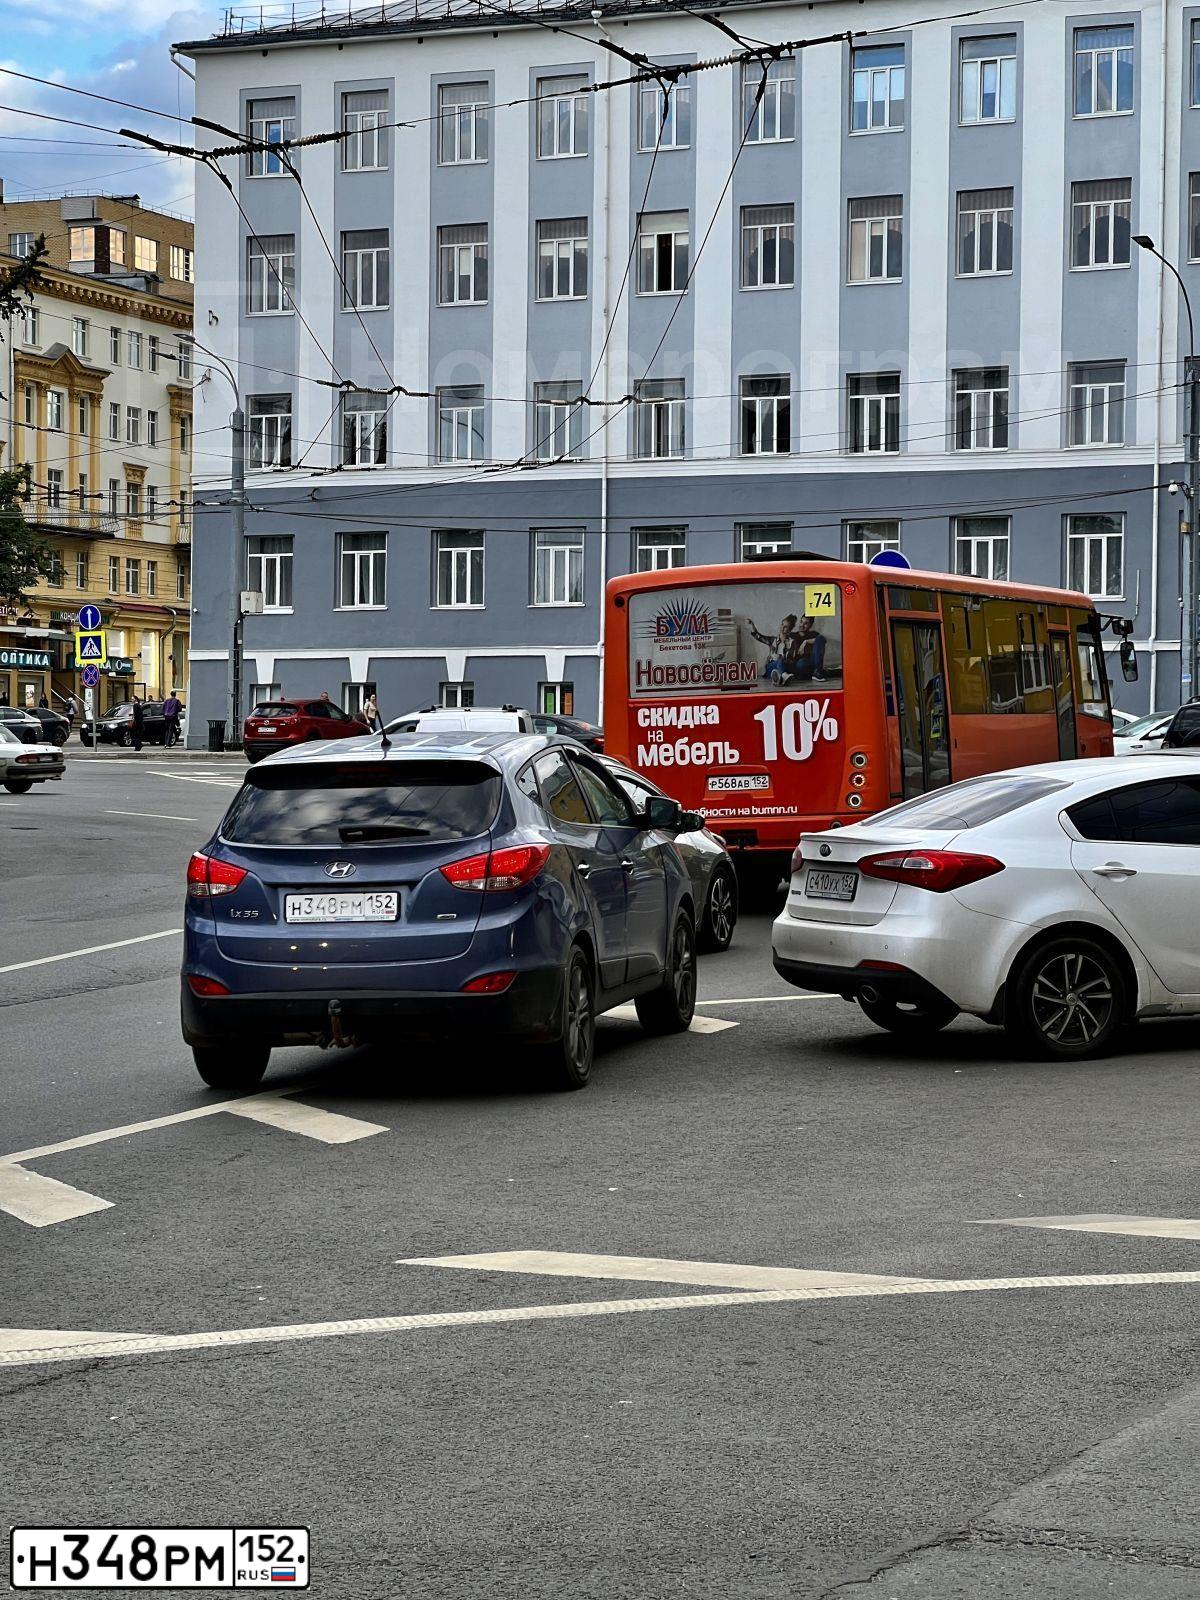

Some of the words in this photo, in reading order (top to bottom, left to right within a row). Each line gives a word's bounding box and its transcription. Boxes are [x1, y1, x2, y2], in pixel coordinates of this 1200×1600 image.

[655, 613, 709, 636] БУМ
[653, 636, 691, 644] МЕБЕЛЬНЫЙ
[1, 652, 49, 666] ОПТИКА
[635, 657, 758, 687] Новосёлам
[637, 704, 719, 728] скидка
[648, 730, 663, 742] на
[754, 699, 838, 761] 10%
[638, 737, 740, 767] мебель
[711, 778, 750, 789] Р568АВ
[751, 776, 767, 785] 152
[738, 807, 751, 815] на
[752, 804, 798, 815] bumnn.ru
[841, 875, 853, 888] 152
[292, 898, 362, 915] Н348РМ
[366, 894, 392, 908] 152
